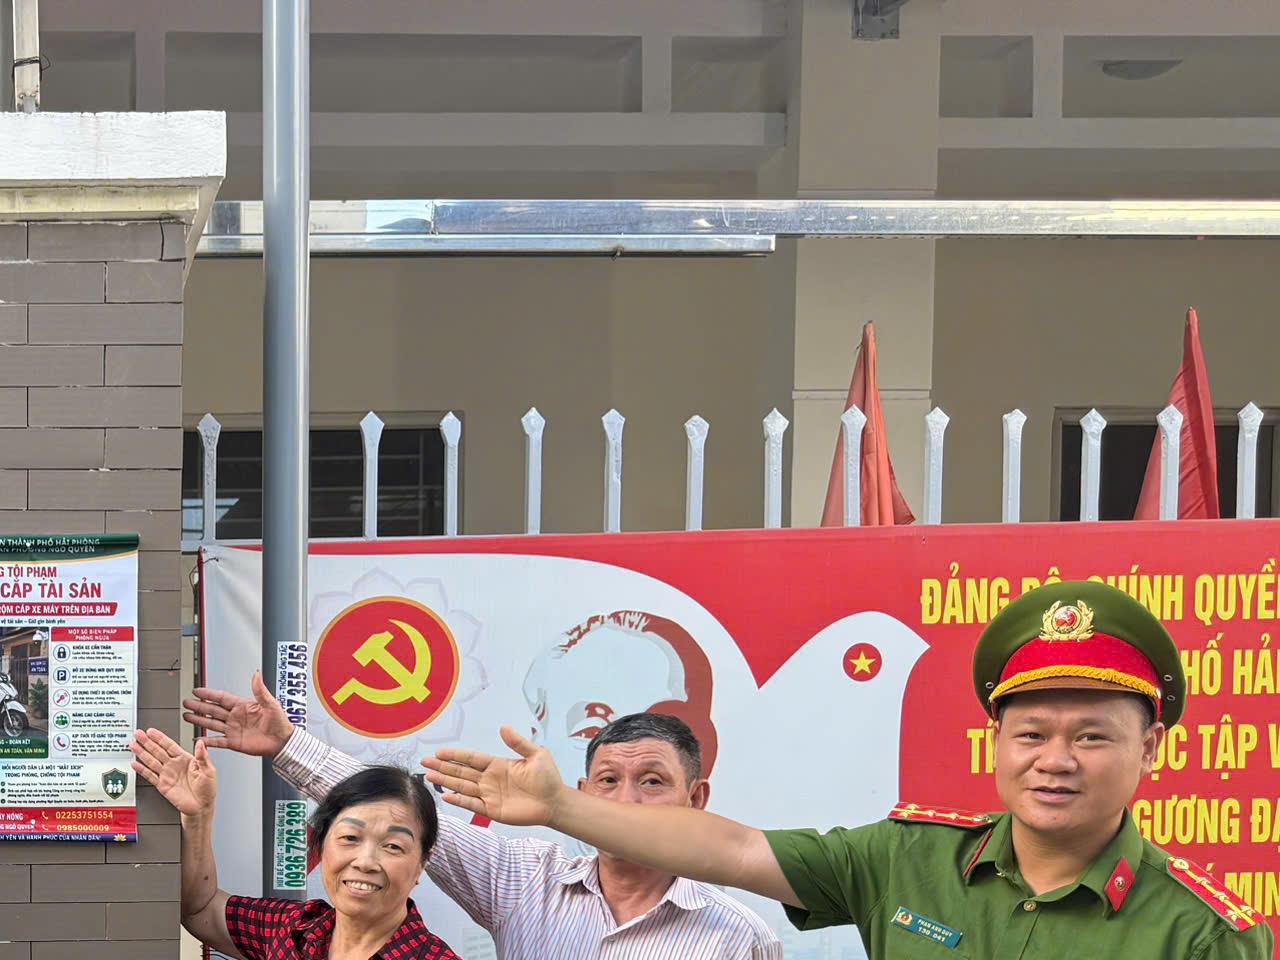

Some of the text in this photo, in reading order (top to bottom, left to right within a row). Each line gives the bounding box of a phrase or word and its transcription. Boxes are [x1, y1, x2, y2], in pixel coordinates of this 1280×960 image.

[8, 537, 35, 546] THÀNH
[56, 536, 69, 546] HẢI
[72, 537, 100, 545] PHÒNG
[7, 564, 24, 580] TỘI
[26, 567, 57, 580] PHẠM
[37, 580, 63, 598] TÀI
[69, 577, 102, 598] SẢN
[920, 562, 1010, 624] ĐẢNG
[1195, 558, 1280, 626] QUYỀ
[32, 606, 42, 614] XE
[43, 603, 60, 614] MÁY
[60, 604, 80, 614] TRÊN
[81, 605, 94, 616] ĐỊA
[95, 604, 111, 614] BÀN
[1181, 632, 1224, 695] HỐ
[1198, 714, 1258, 780] TẬP
[1268, 724, 1280, 769] V
[56, 811, 113, 820] 02253751554
[1224, 872, 1280, 917] MIN
